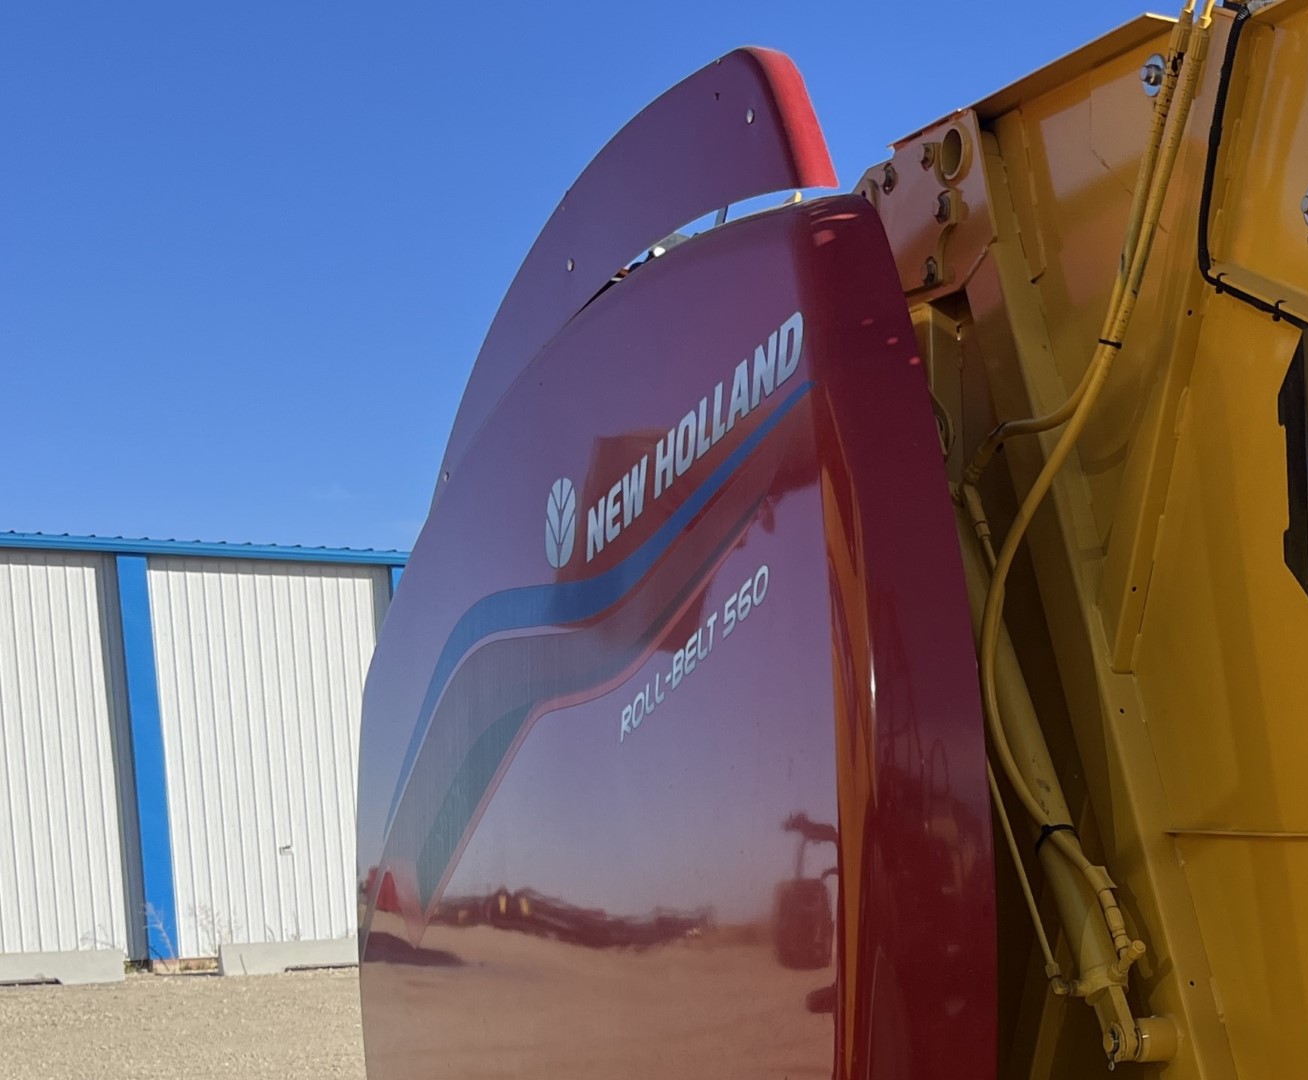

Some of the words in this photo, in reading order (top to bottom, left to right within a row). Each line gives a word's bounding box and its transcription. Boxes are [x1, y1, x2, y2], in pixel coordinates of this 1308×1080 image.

[586, 454, 648, 563] NEW
[654, 311, 804, 500] HOLLAND
[620, 611, 718, 743] ROLL-BELT
[722, 564, 769, 639] 560
